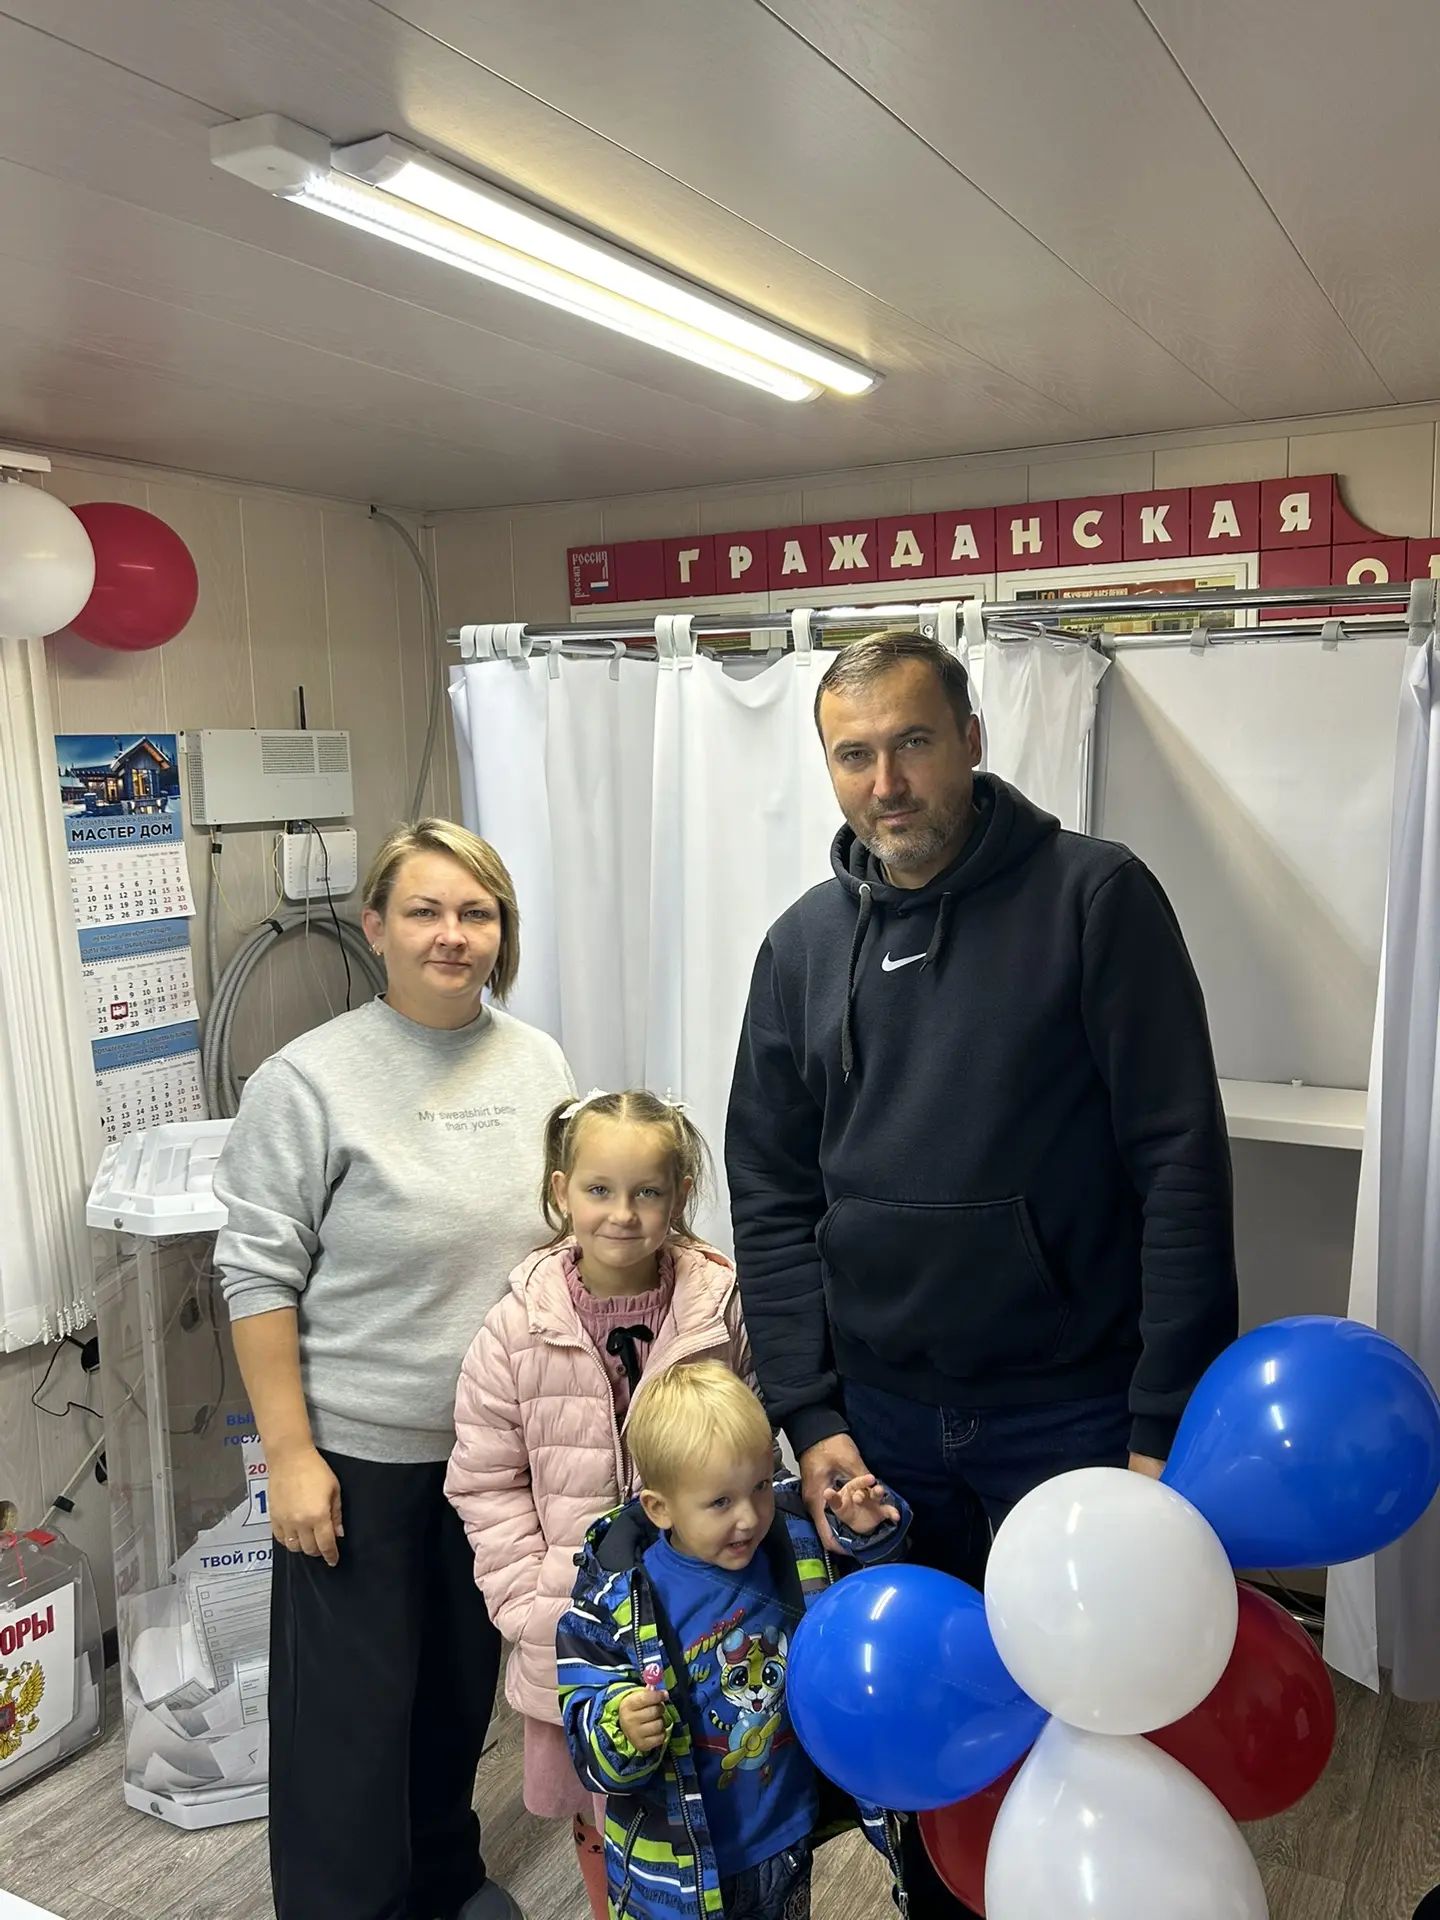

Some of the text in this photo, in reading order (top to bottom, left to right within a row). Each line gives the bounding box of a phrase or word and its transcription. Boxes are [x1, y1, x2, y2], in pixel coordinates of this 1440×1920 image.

[678, 492, 1312, 584] ГРАЖДАНСКАЯ
[71, 823, 173, 842] МАСТЕР ДОМ
[98, 1016, 107, 1024] 21
[418, 1110, 435, 1122] My
[439, 1107, 491, 1119] sweatshirt
[445, 1121, 468, 1131] than
[248, 1463, 269, 1475] 20
[200, 1550, 243, 1568] ТВОЙ
